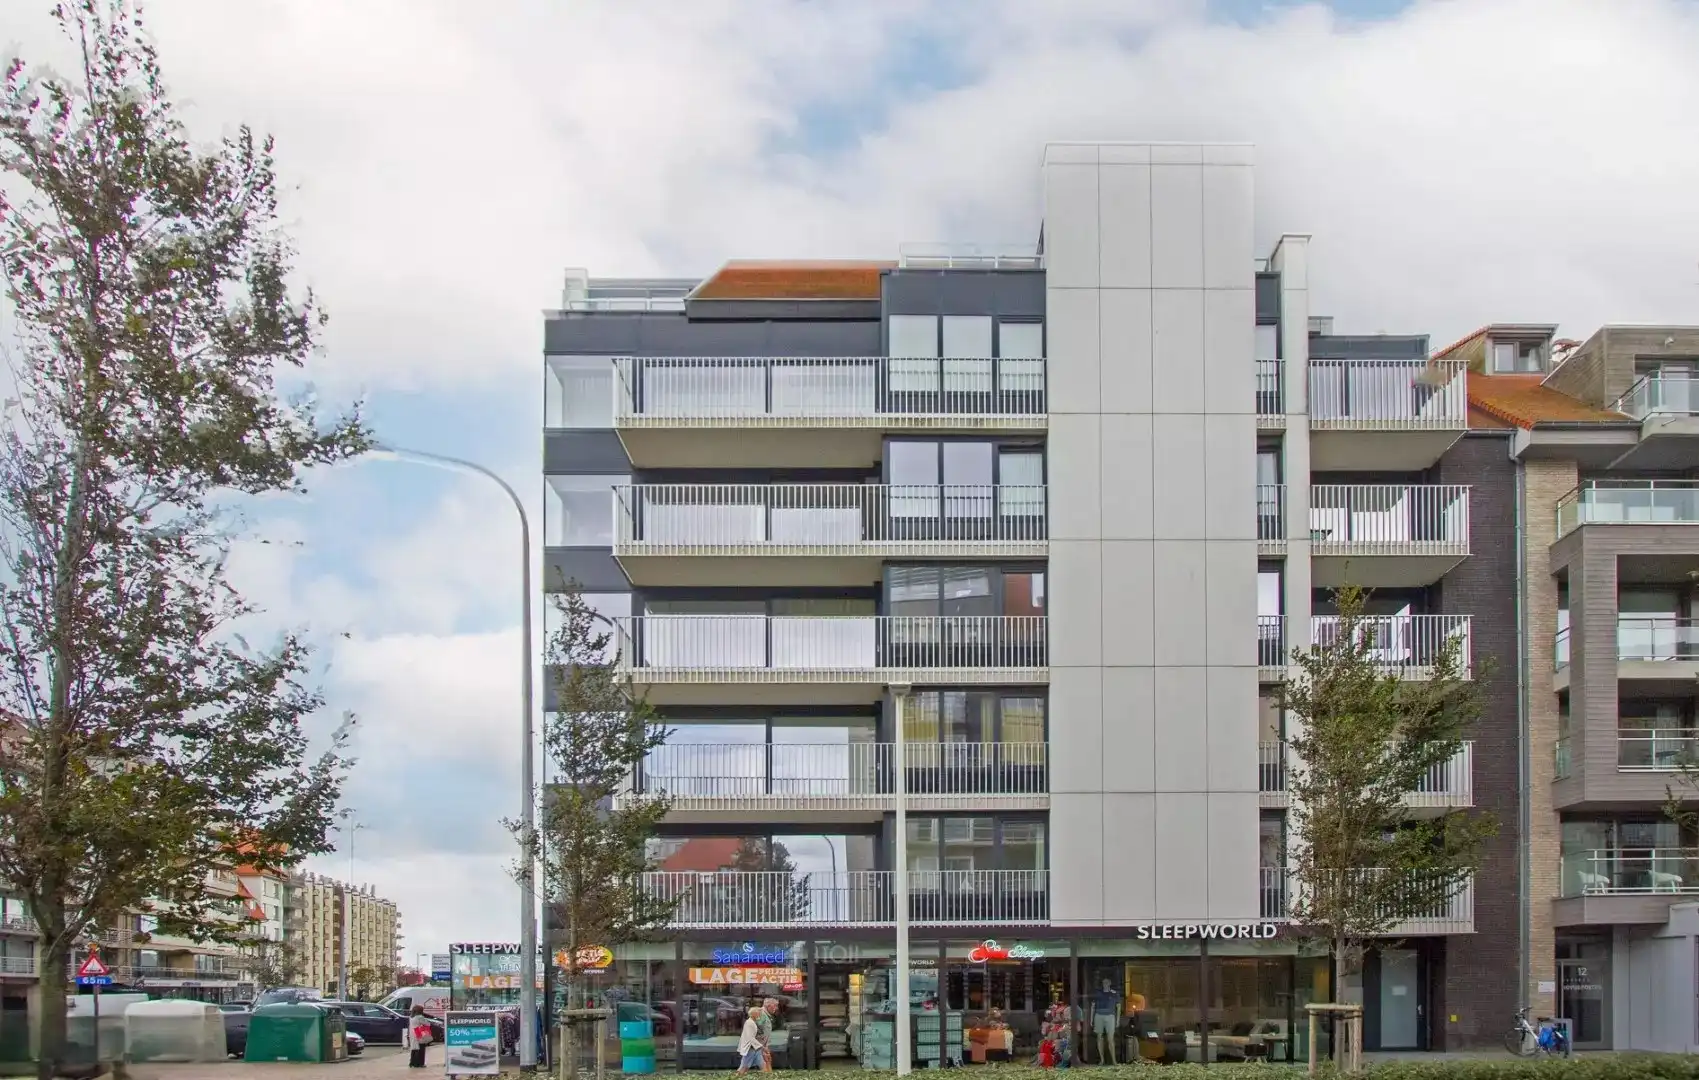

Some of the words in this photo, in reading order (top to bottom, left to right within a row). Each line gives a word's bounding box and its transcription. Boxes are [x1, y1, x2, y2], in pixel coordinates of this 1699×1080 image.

[1137, 924, 1277, 939] SLEEPWORLD
[713, 949, 785, 964] Sanamed
[696, 968, 760, 984] LAGE
[1578, 967, 1588, 976] 12
[469, 976, 521, 988] LAGE
[760, 975, 798, 984] ACTIE
[449, 1028, 471, 1036] 50%
